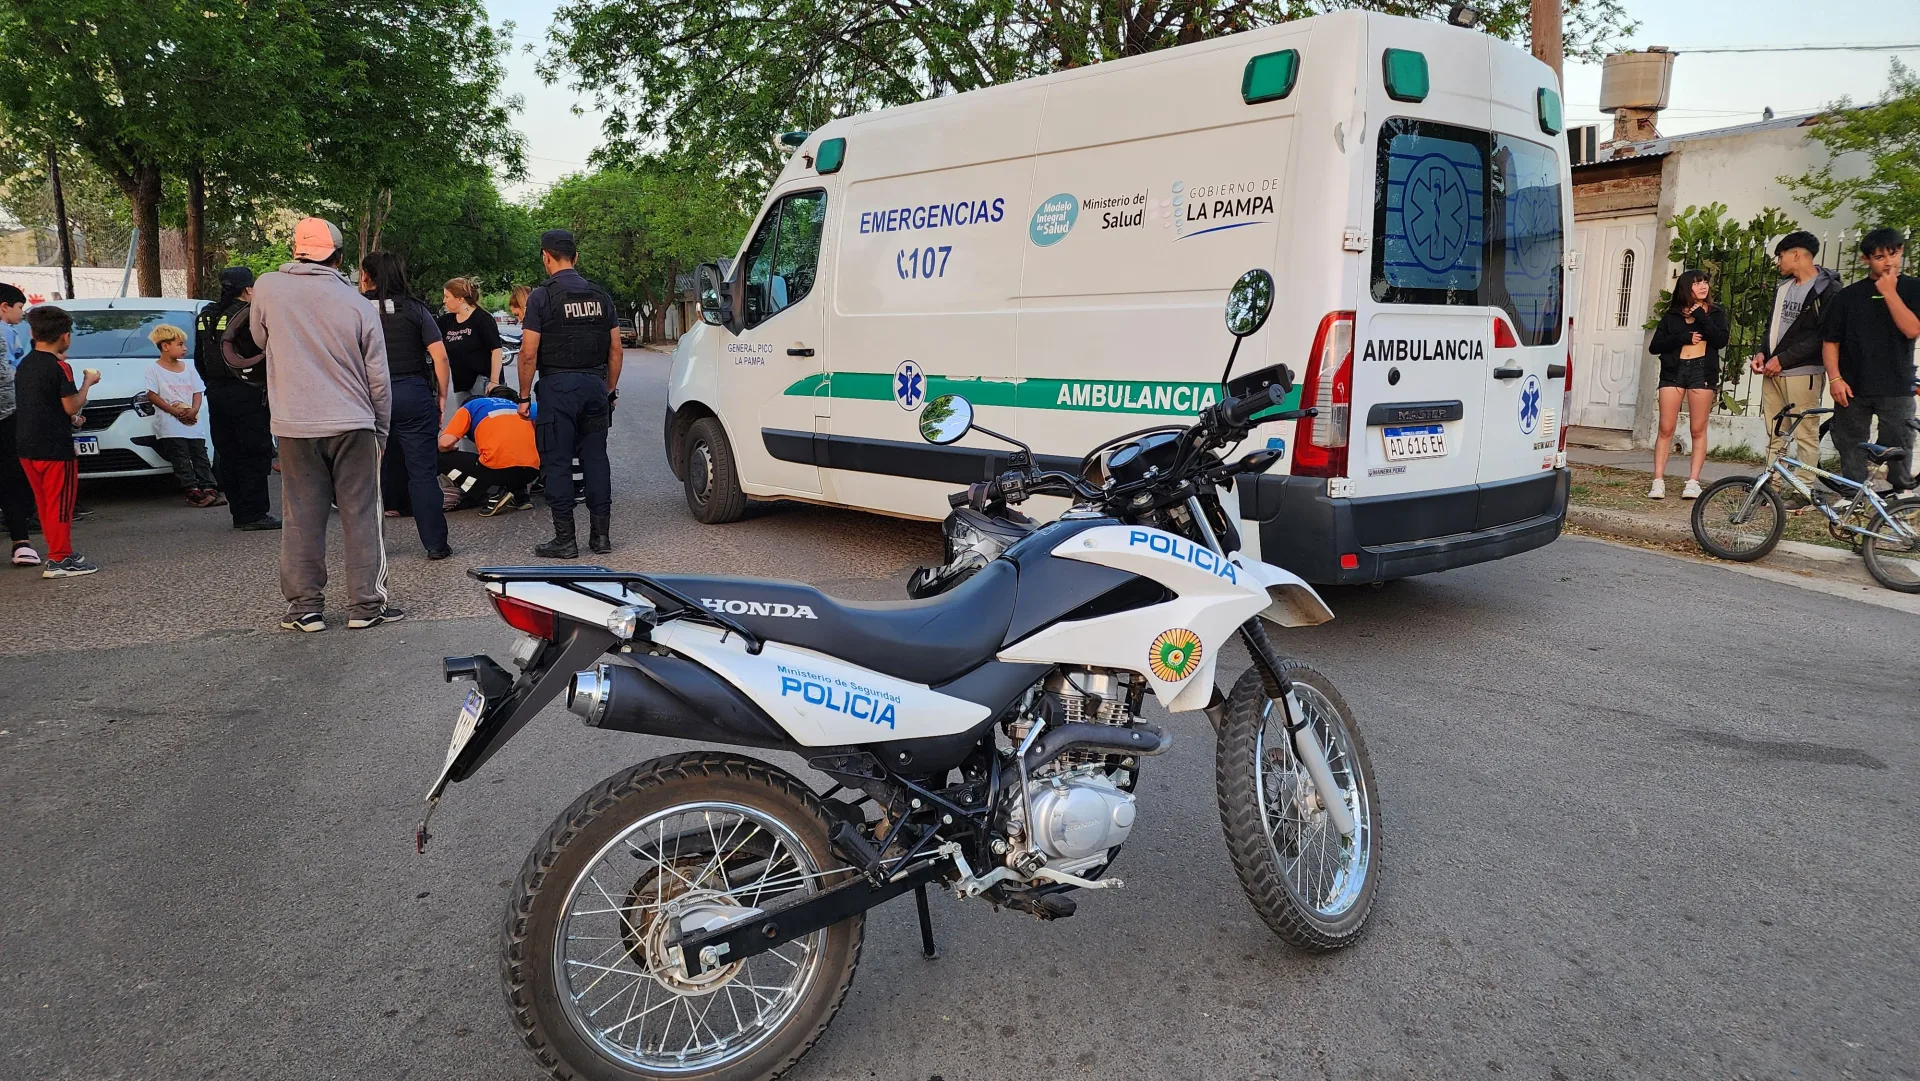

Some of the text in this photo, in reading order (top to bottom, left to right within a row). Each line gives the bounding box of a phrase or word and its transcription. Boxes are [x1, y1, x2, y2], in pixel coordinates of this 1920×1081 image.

[1189, 178, 1279, 199] GOBIERNO DE
[1043, 200, 1072, 213] Modelo
[1082, 193, 1145, 211] Ministerio de
[1186, 195, 1274, 221] LA PAMPA
[859, 197, 1005, 234] EMERGENCIAS
[1036, 211, 1066, 224] Integral
[1101, 208, 1143, 230] Salud
[1036, 220, 1070, 235] de Salud
[908, 245, 953, 280] 107
[563, 301, 603, 319] POLICIA
[727, 343, 773, 354] GENERAL PICO
[1362, 339, 1484, 362] AMBULANCIA
[734, 356, 766, 367] LA PAMPA
[1056, 383, 1217, 412] AMBULANCIA
[1397, 409, 1447, 421] MASTER
[1390, 435, 1445, 456] AD 616 EH
[1129, 530, 1238, 586] POLICIA
[700, 598, 819, 620] HONDA
[777, 664, 902, 705] Ministerio de Seguridad
[781, 676, 896, 730] POLICIA
